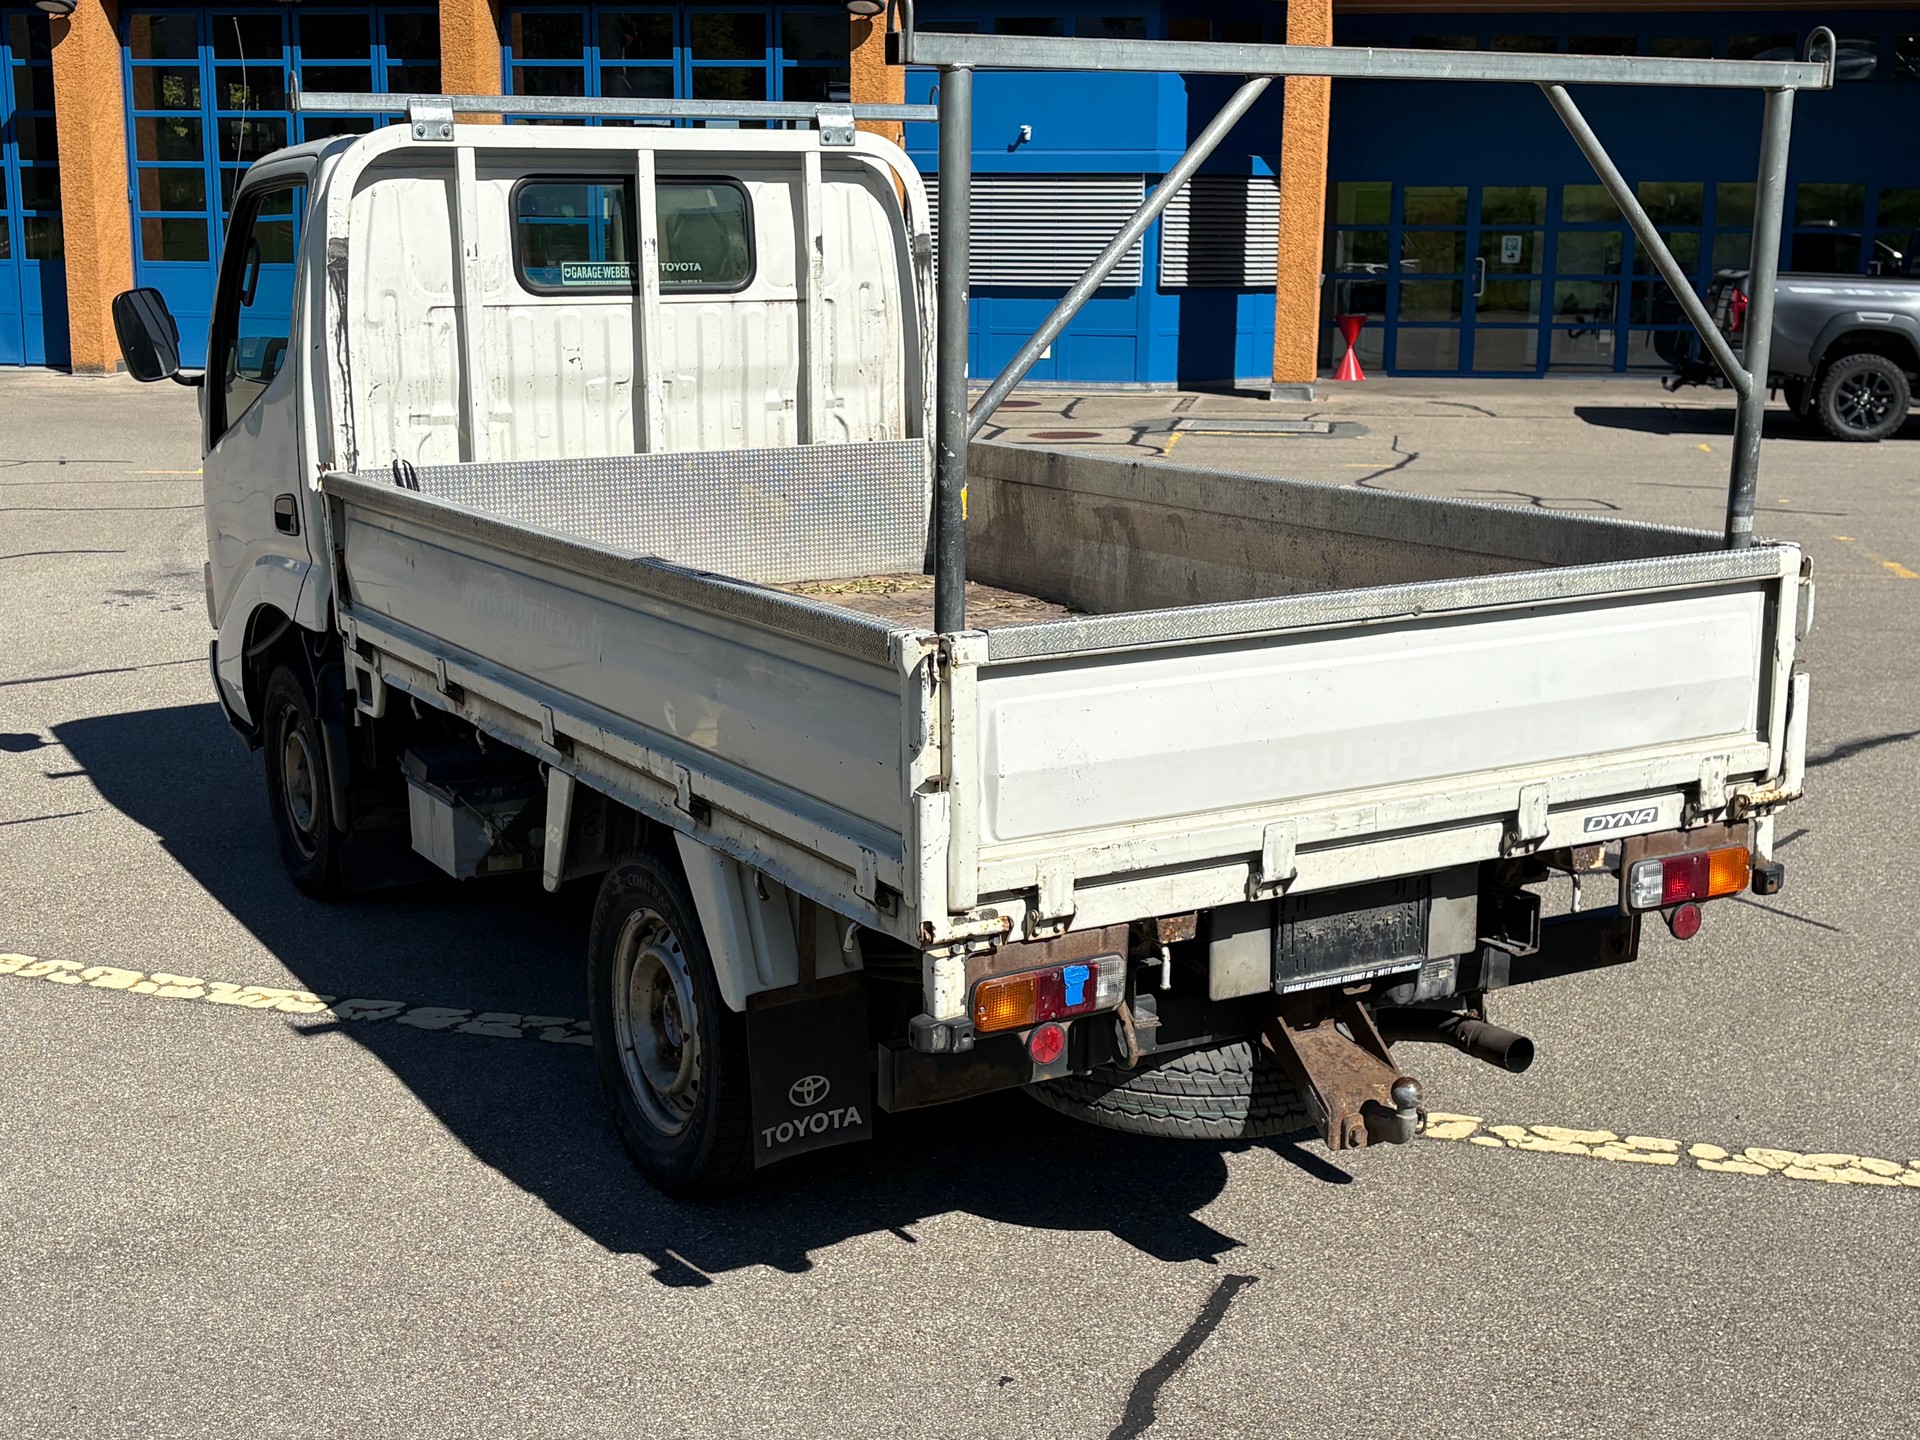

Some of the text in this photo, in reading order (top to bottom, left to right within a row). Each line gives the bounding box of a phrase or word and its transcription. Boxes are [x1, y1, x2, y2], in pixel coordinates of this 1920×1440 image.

[660, 262, 702, 272] TOYOTA
[1586, 808, 1656, 832] DYNA
[1283, 983, 1306, 994] GARAGE
[1305, 976, 1342, 990] CARROSSERIE
[761, 1106, 863, 1148] TOYOTA
